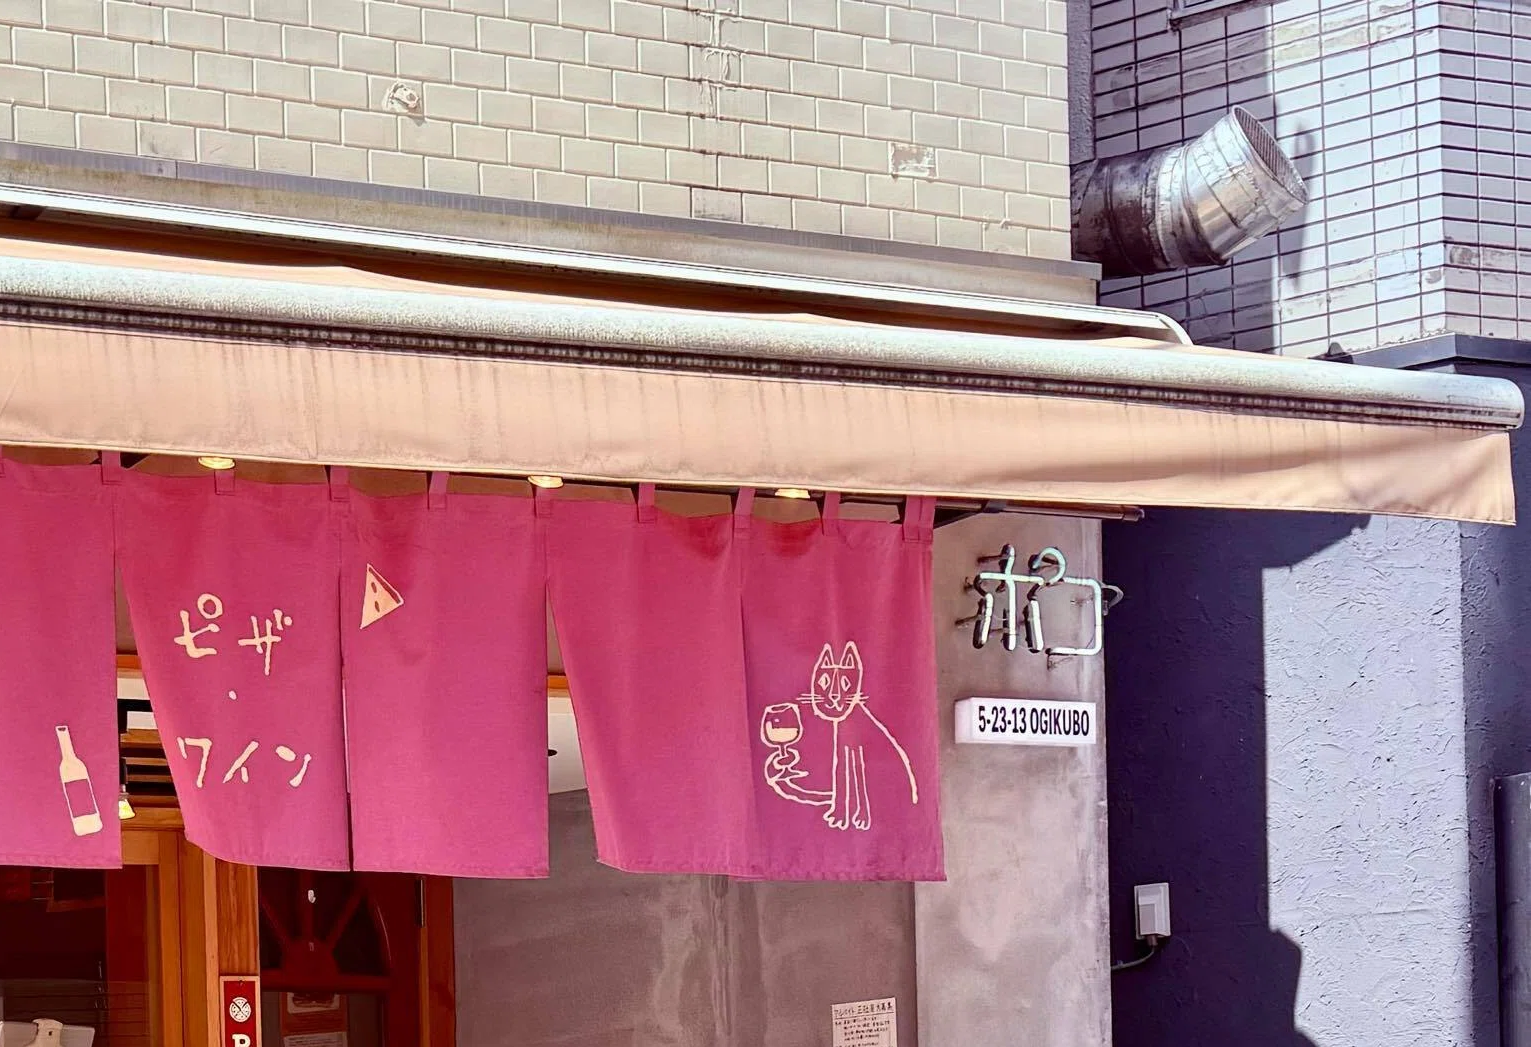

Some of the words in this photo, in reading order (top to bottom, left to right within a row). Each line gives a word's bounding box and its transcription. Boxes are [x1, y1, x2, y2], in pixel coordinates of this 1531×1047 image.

[973, 544, 1104, 655] ポコ
[173, 592, 294, 676] ピザ
[978, 705, 1027, 733] 5-23-13
[1030, 707, 1090, 736] OGIKUBO
[176, 736, 313, 788] ワイン
